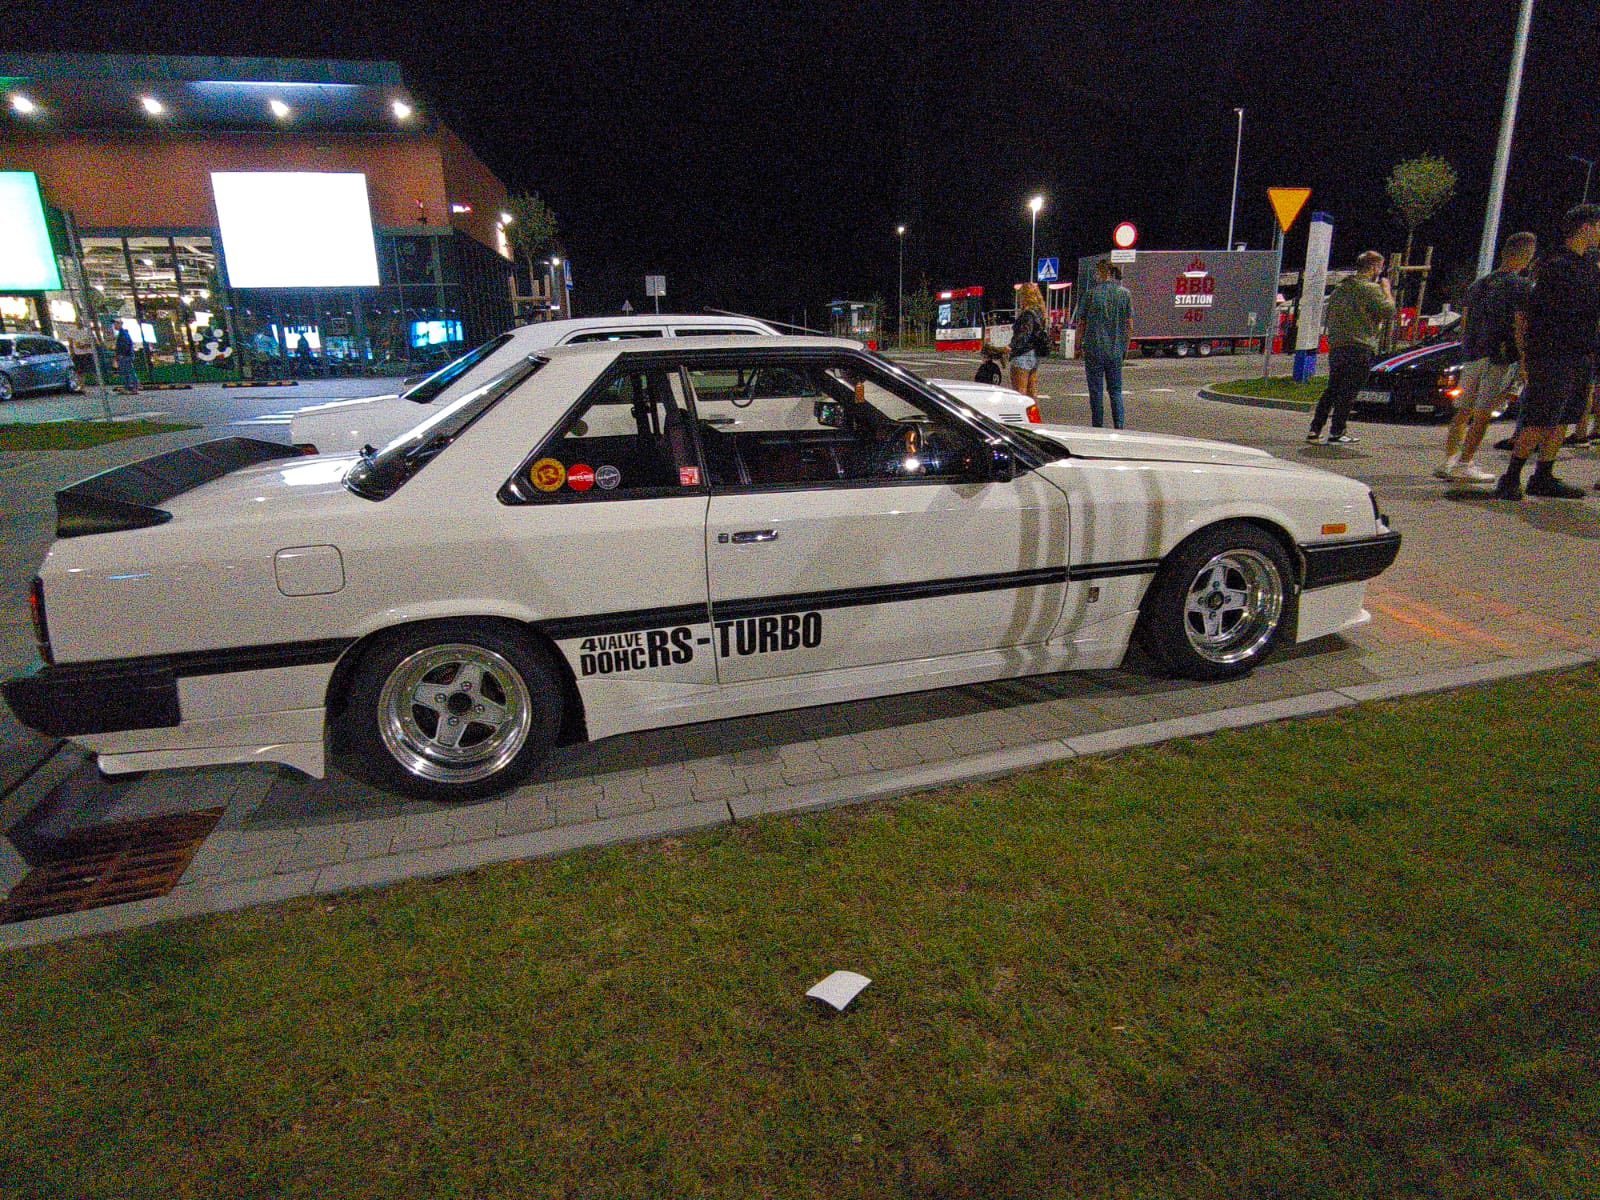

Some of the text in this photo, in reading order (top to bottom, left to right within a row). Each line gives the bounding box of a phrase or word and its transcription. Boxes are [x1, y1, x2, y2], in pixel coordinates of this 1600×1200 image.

[1175, 276, 1216, 295] BBQ
[1174, 295, 1213, 305] STATION
[580, 647, 647, 676] DOHC
